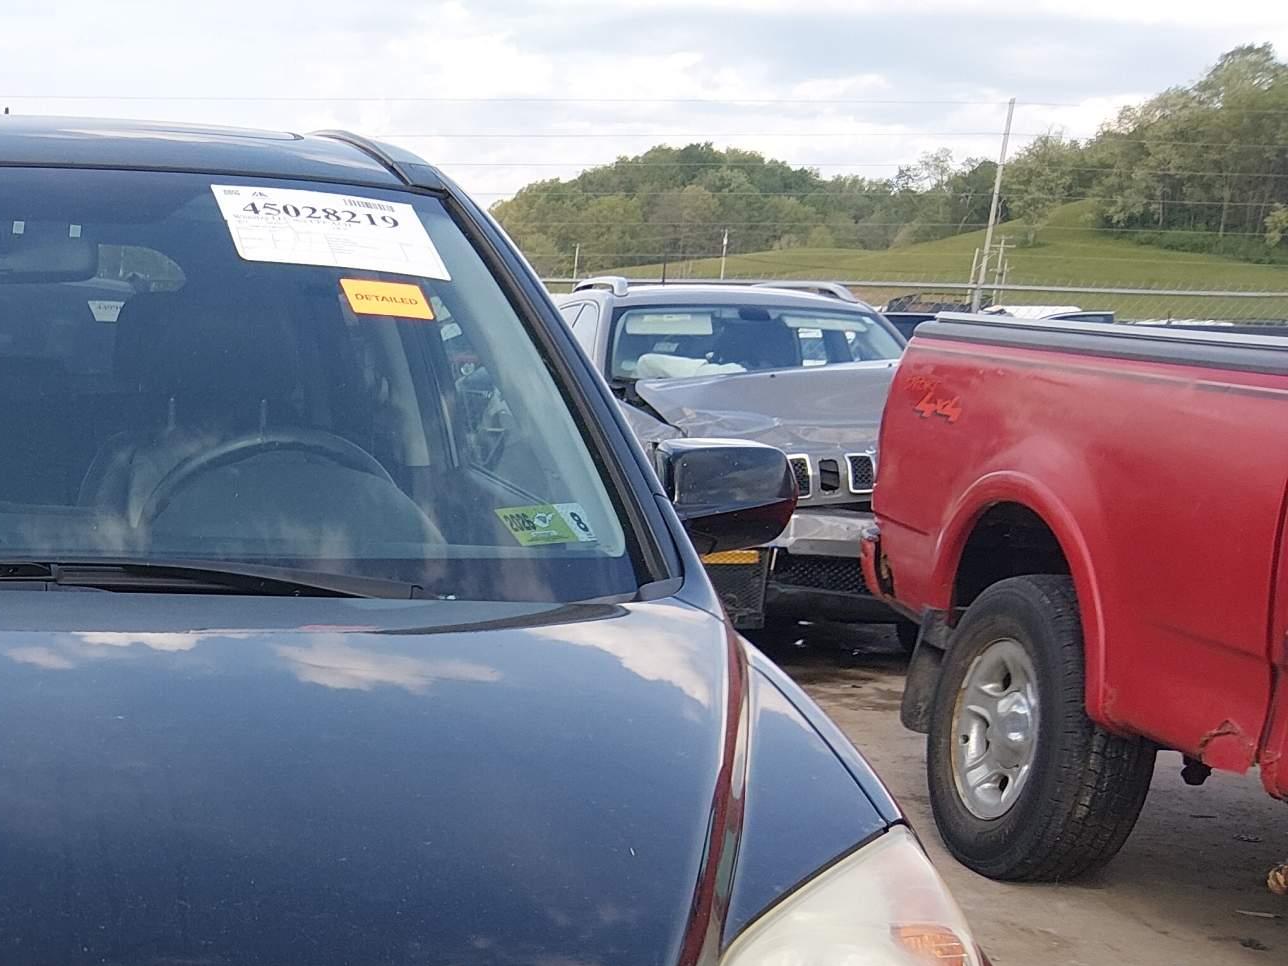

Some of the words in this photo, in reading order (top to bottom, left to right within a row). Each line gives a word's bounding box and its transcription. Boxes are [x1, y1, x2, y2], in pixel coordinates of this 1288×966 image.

[242, 201, 400, 229] 45028219
[354, 292, 418, 306] DETAILED
[503, 512, 537, 532] 2026
[569, 511, 590, 533] 8
